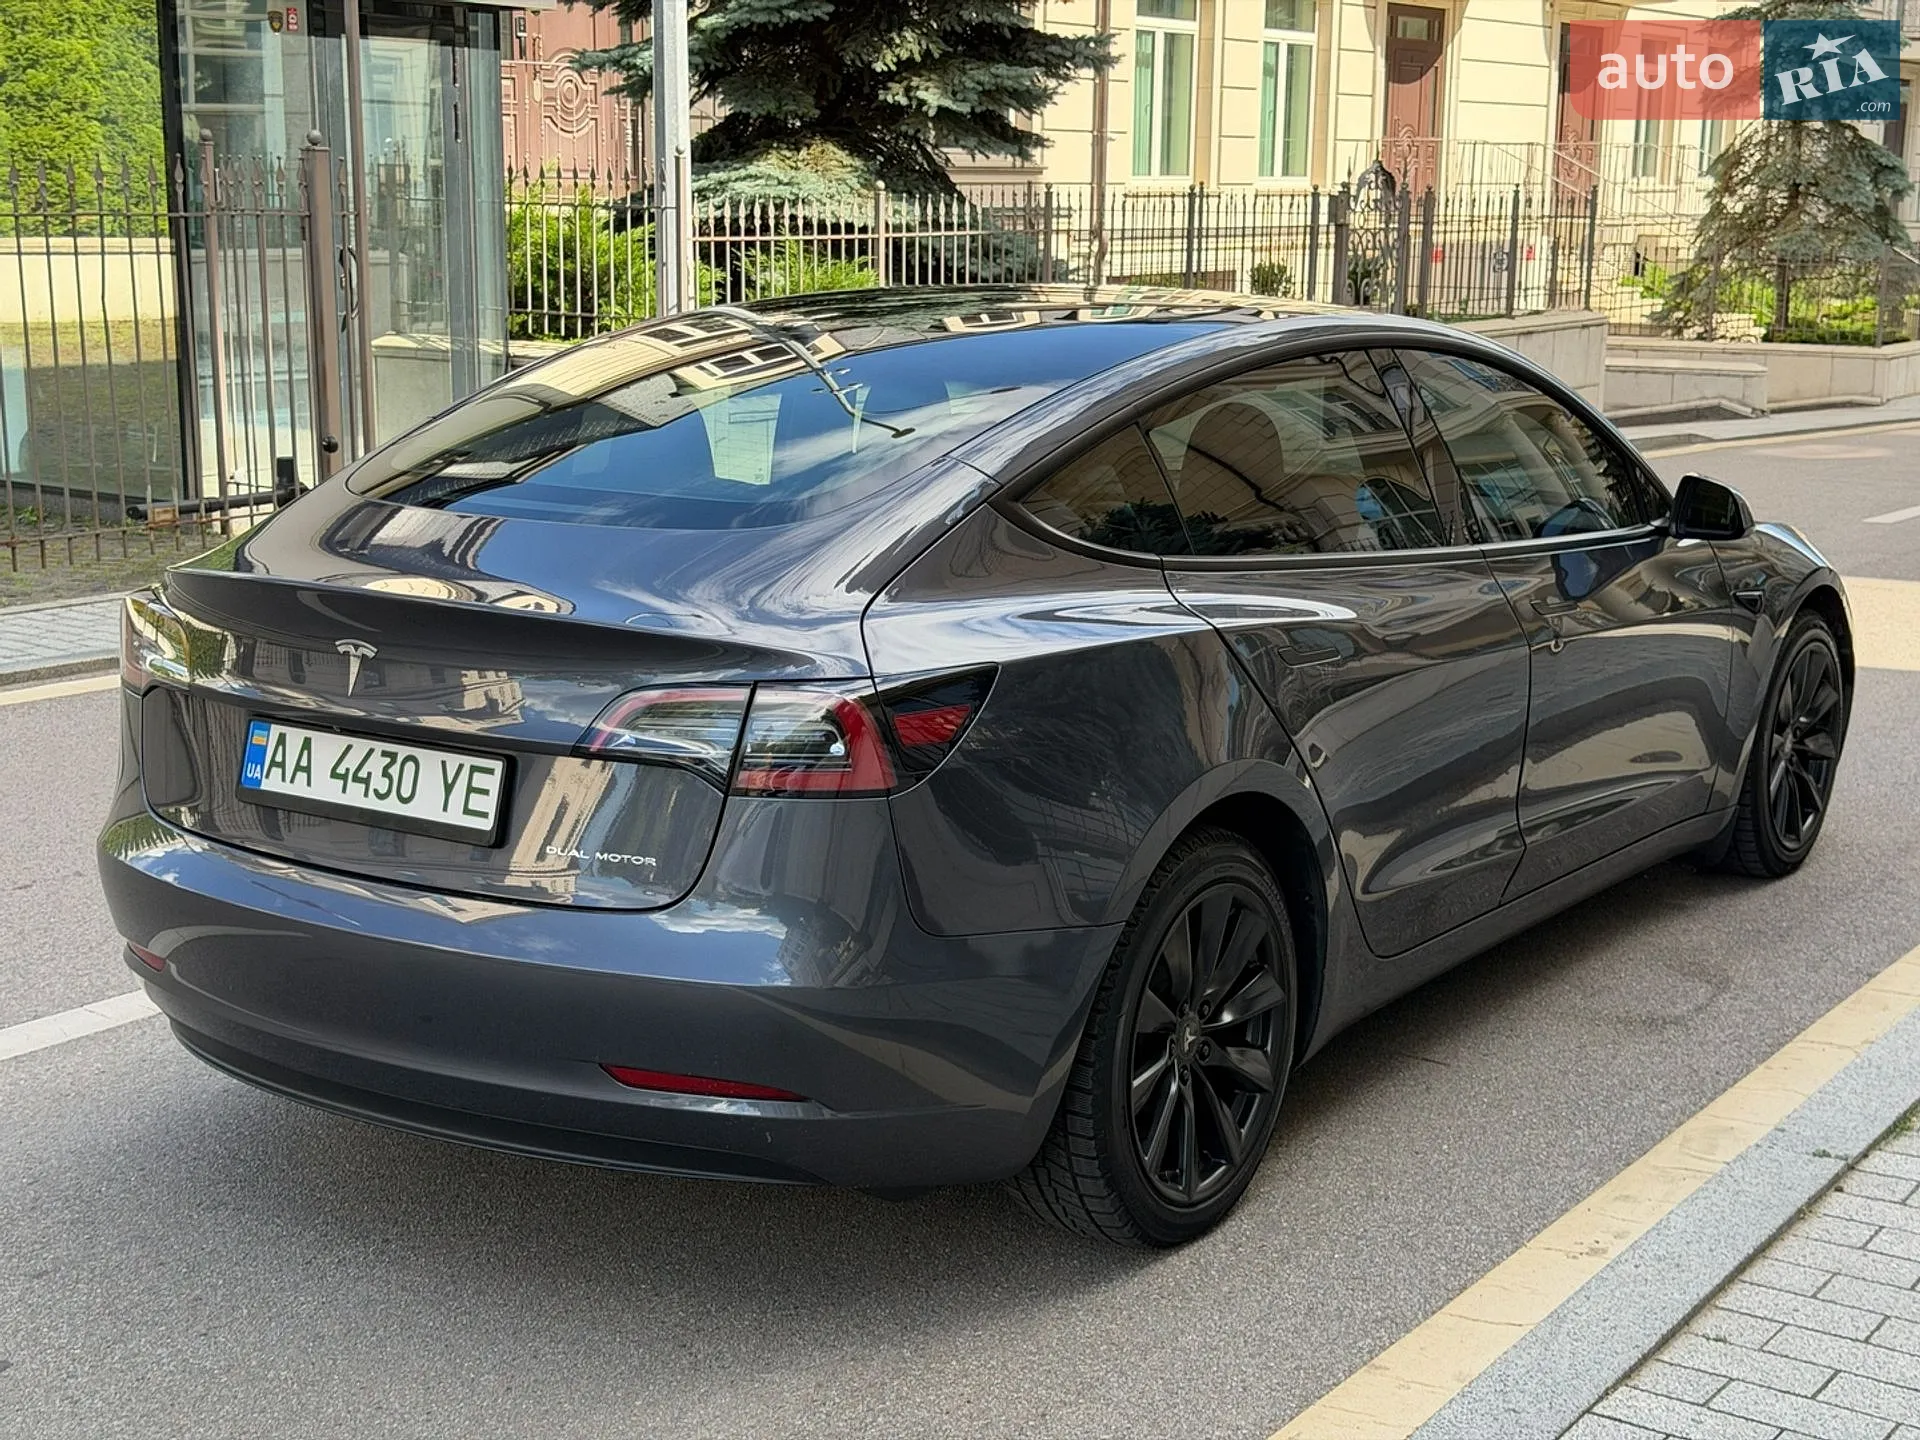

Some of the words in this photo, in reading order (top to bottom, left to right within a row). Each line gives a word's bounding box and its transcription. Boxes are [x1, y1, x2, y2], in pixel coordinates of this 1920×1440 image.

[246, 763, 262, 780] UA
[265, 732, 313, 788] AA
[329, 743, 420, 805] 4430
[441, 759, 496, 819] YE
[546, 845, 590, 859] DUAL
[594, 851, 657, 867] MOTOR
